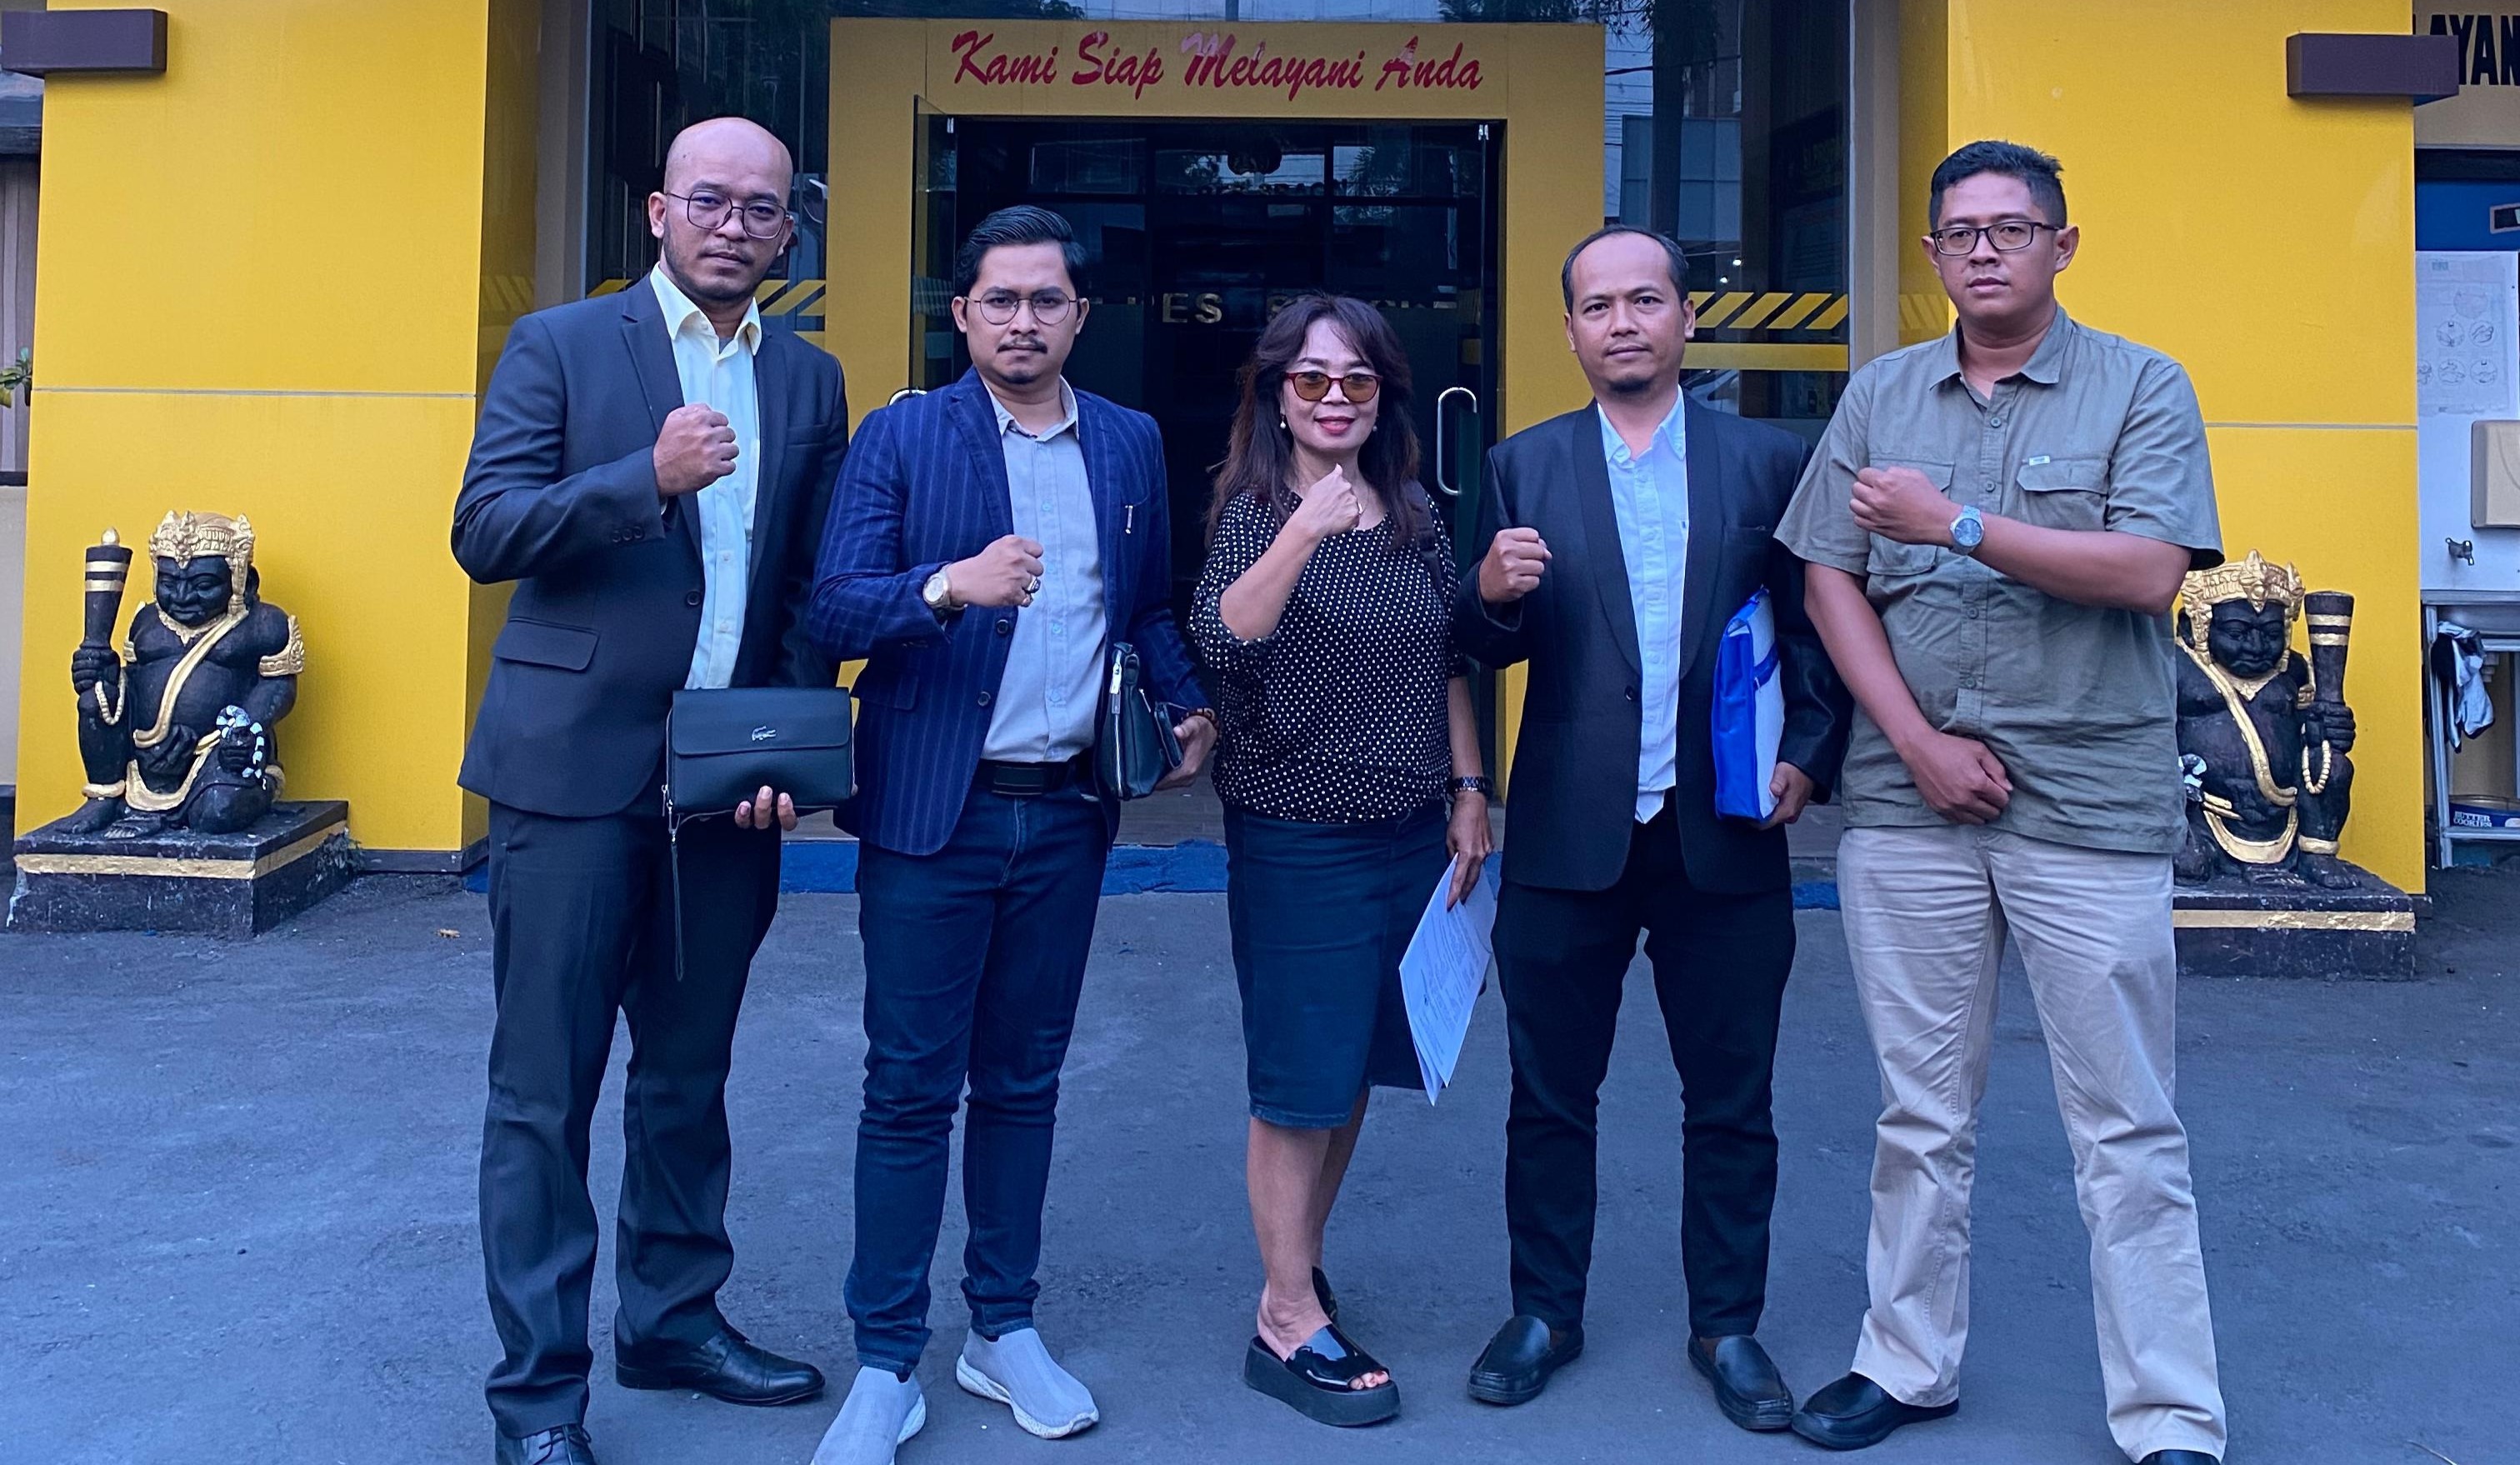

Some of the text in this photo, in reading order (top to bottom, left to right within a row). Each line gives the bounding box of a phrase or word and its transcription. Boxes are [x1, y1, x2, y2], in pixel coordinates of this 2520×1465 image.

[951, 30, 1484, 102] Kami Siap Melayani Anda
